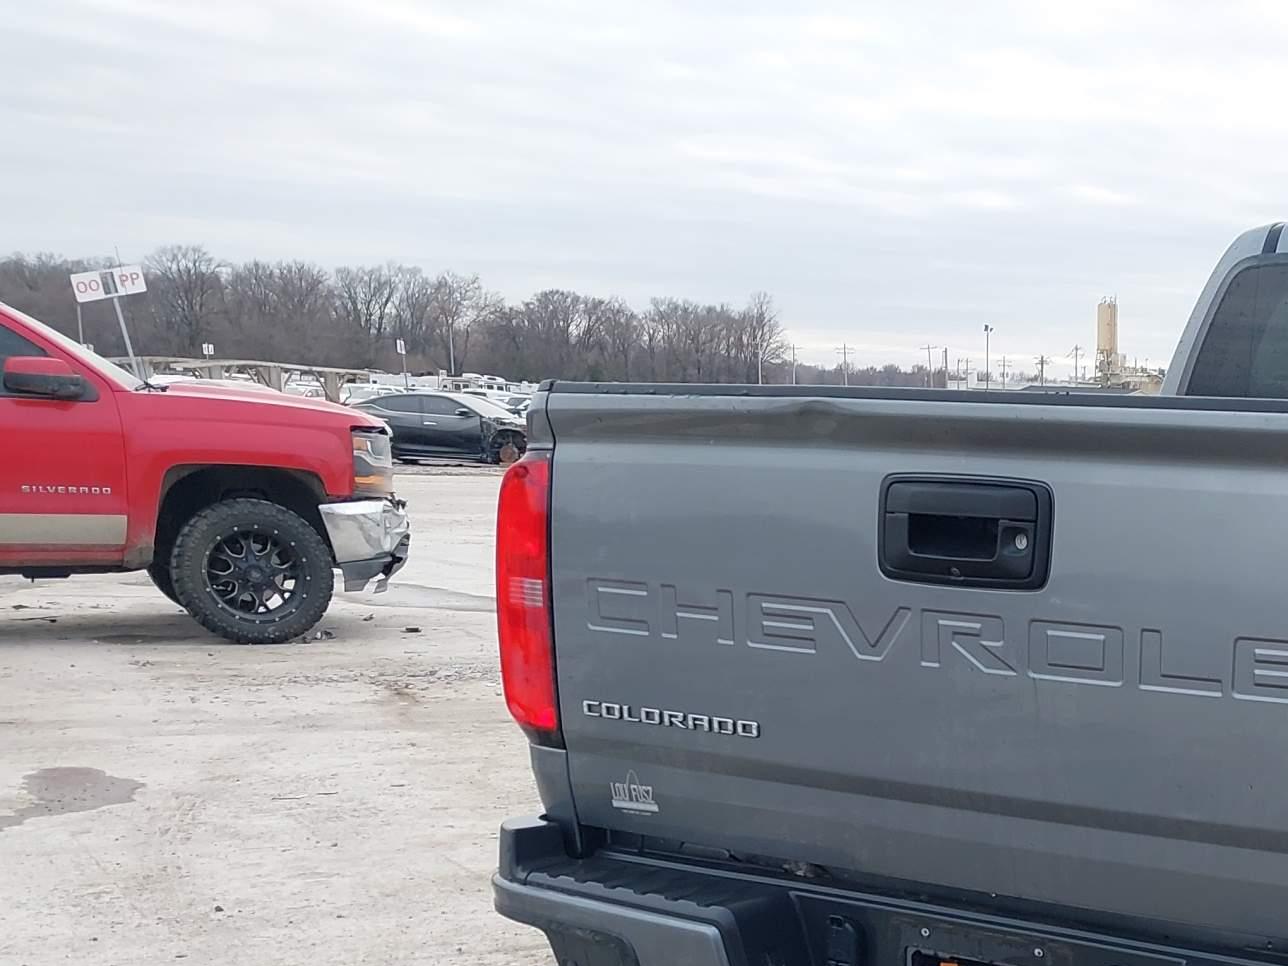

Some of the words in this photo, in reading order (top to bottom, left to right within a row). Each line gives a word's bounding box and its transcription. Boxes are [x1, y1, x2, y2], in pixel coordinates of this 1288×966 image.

[76, 279, 100, 294] OO
[119, 272, 140, 288] PP
[21, 485, 112, 495] SILVERADO
[582, 699, 761, 739] COLORADO
